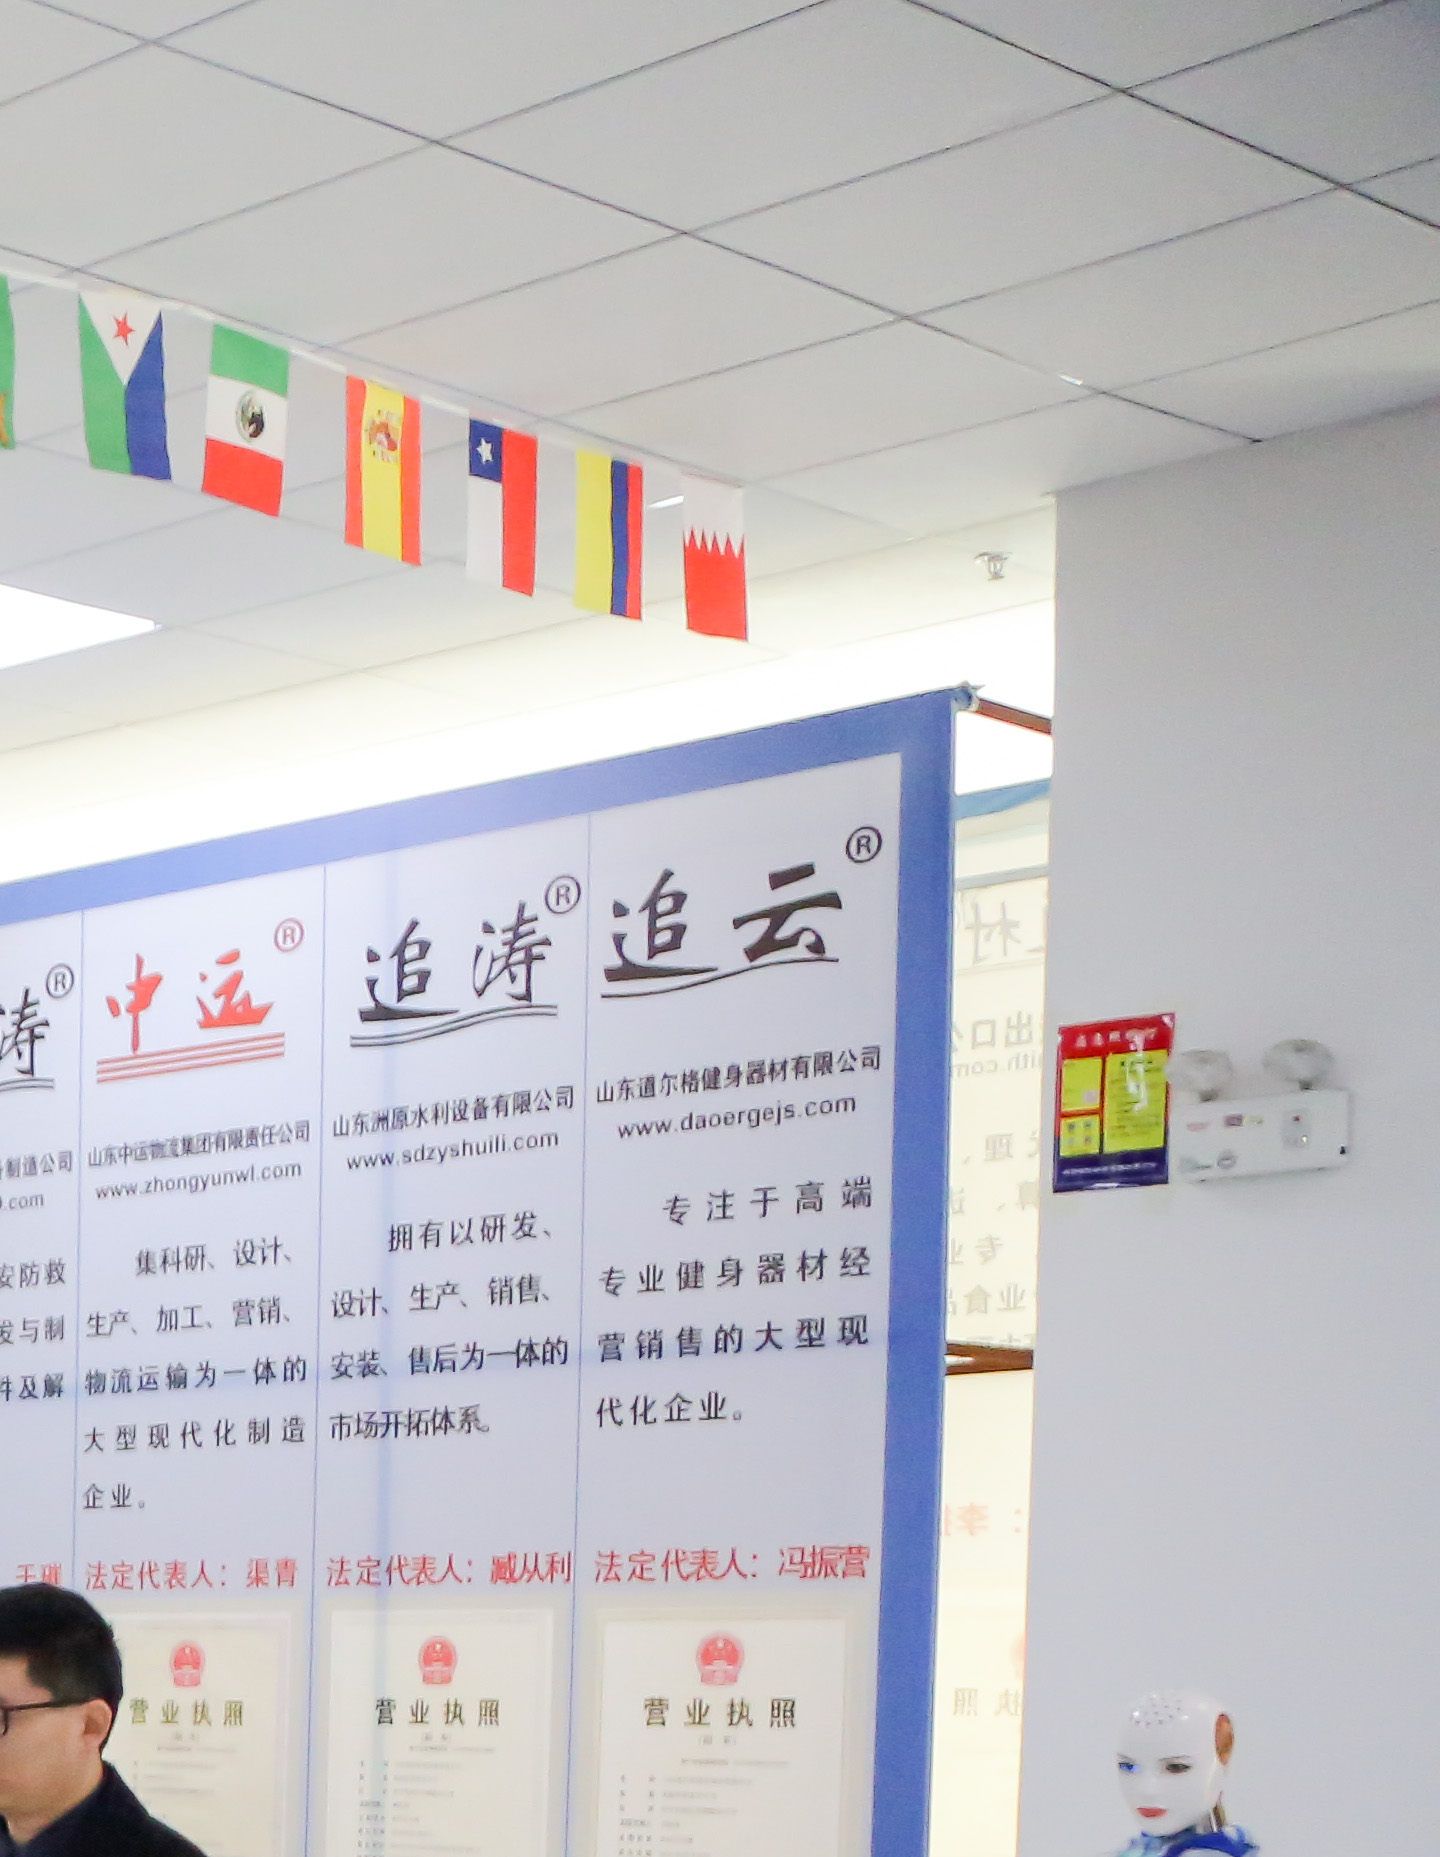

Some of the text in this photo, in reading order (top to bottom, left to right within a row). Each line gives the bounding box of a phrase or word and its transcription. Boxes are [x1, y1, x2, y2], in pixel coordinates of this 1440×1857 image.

[602, 861, 842, 982] 追云
[358, 900, 551, 1022] 追涛
[106, 949, 274, 1054] 中运
[596, 1044, 882, 1105] 山东道尔格健身器材有限公司
[332, 1085, 575, 1139] 山东洲原水利设备有限公司
[617, 1092, 856, 1140] www.daoergejs.com
[346, 1128, 559, 1172] www.sdzyshuili.com
[95, 1159, 302, 1201] www.zhongyunwl.com
[663, 1176, 872, 1226] 专注于高端
[387, 1209, 552, 1254] 拥有以研发、
[136, 1236, 293, 1278] 集科研、设计、
[599, 1244, 872, 1297] 专业健身器材经
[86, 1297, 291, 1339] 生产、加工、营销、
[330, 1275, 551, 1320] 设计、生产、销售、
[330, 1336, 569, 1382] 安装、售后为一体的
[598, 1313, 869, 1364] 营销售的大型现
[84, 1351, 307, 1396] 物流运输为一体的
[329, 1403, 491, 1441] 市场开拓体系。
[595, 1390, 742, 1430] 代化企业。
[83, 1415, 306, 1454] 大型现代化制造
[82, 1482, 147, 1511] 企业。
[594, 1545, 871, 1584] 法定代表人：冯振营
[129, 1698, 245, 1728] 营业执照
[375, 1698, 500, 1728] 营业执照
[643, 1697, 797, 1729] 营业执照
